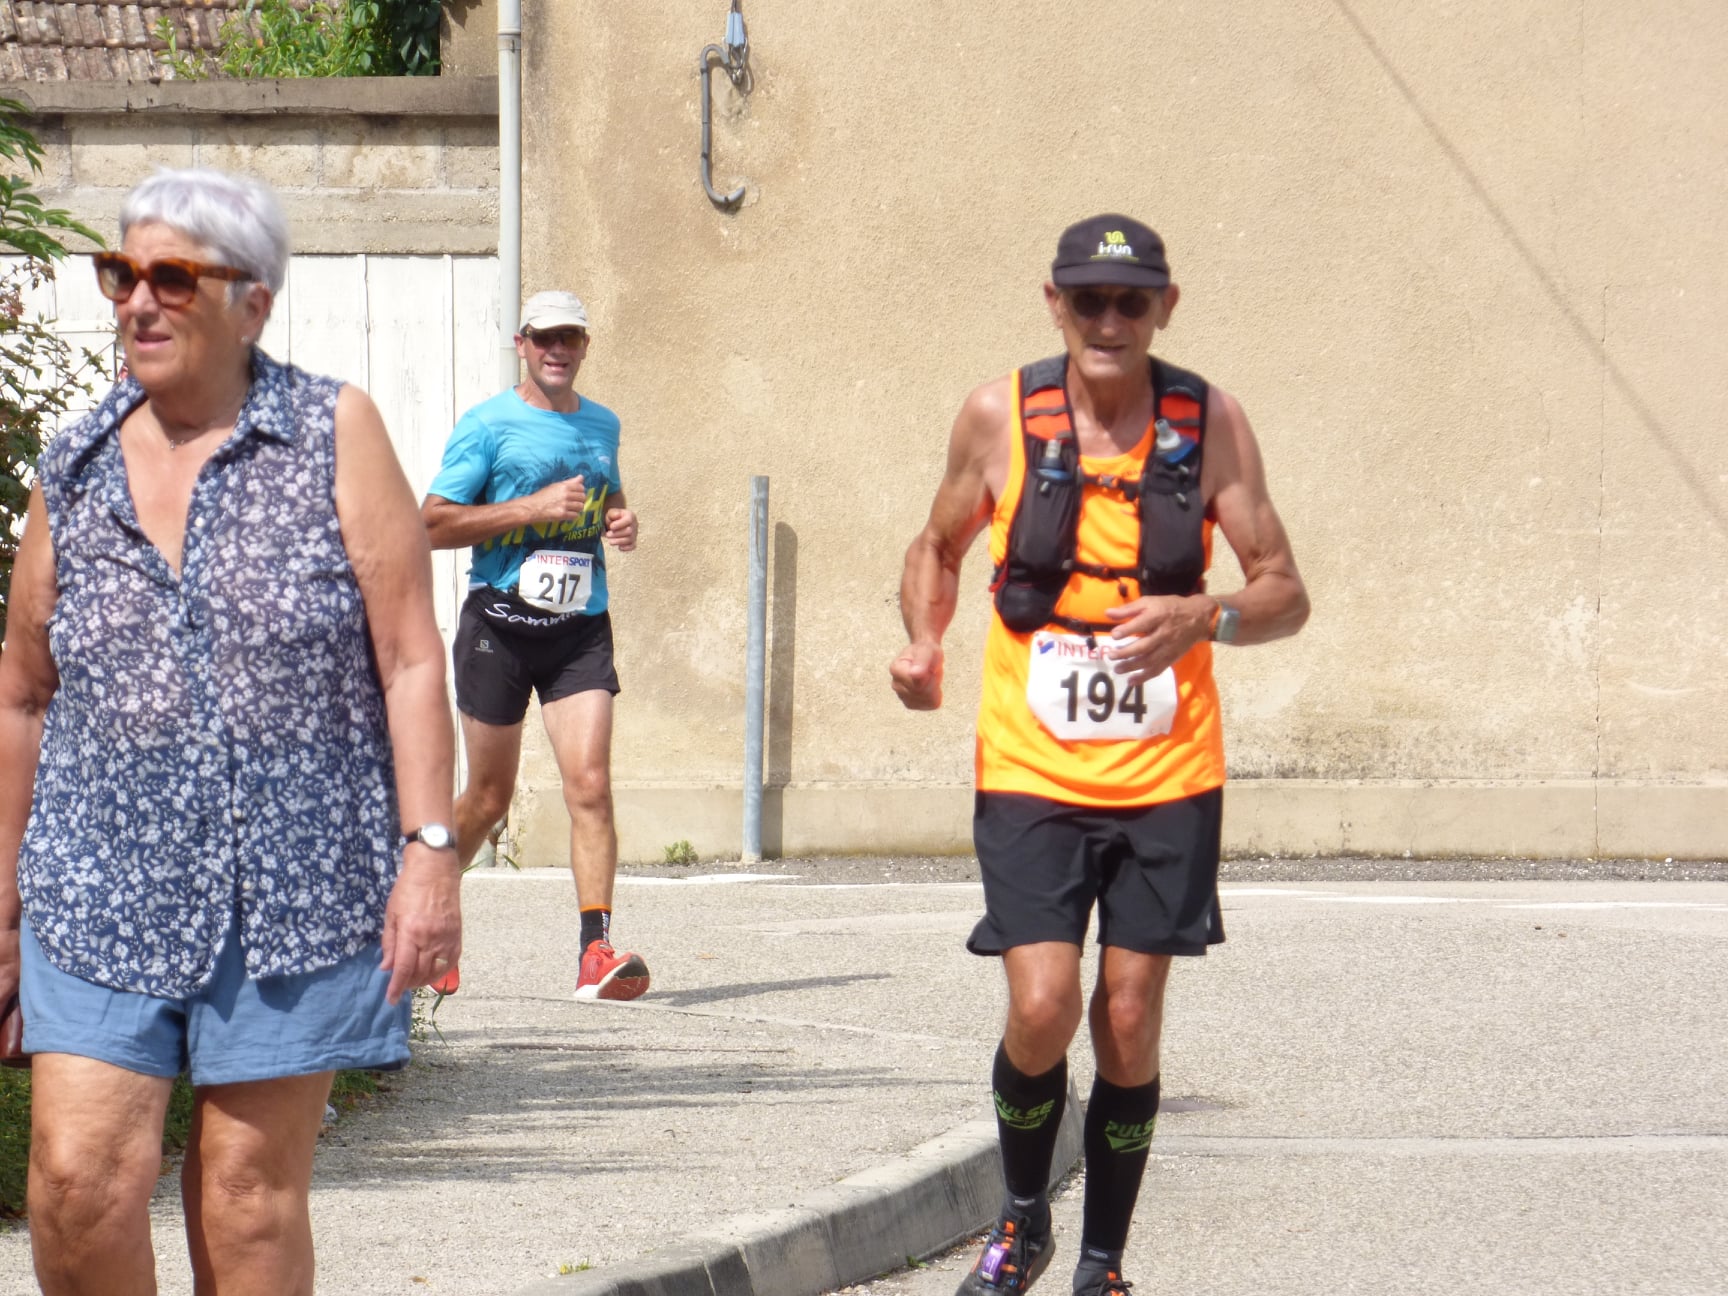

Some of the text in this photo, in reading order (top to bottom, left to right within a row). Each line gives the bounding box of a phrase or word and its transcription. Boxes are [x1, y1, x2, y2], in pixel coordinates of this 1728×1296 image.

[537, 554, 590, 567] INTERSPORT
[538, 572, 581, 604] 217
[1060, 671, 1147, 723] 194
